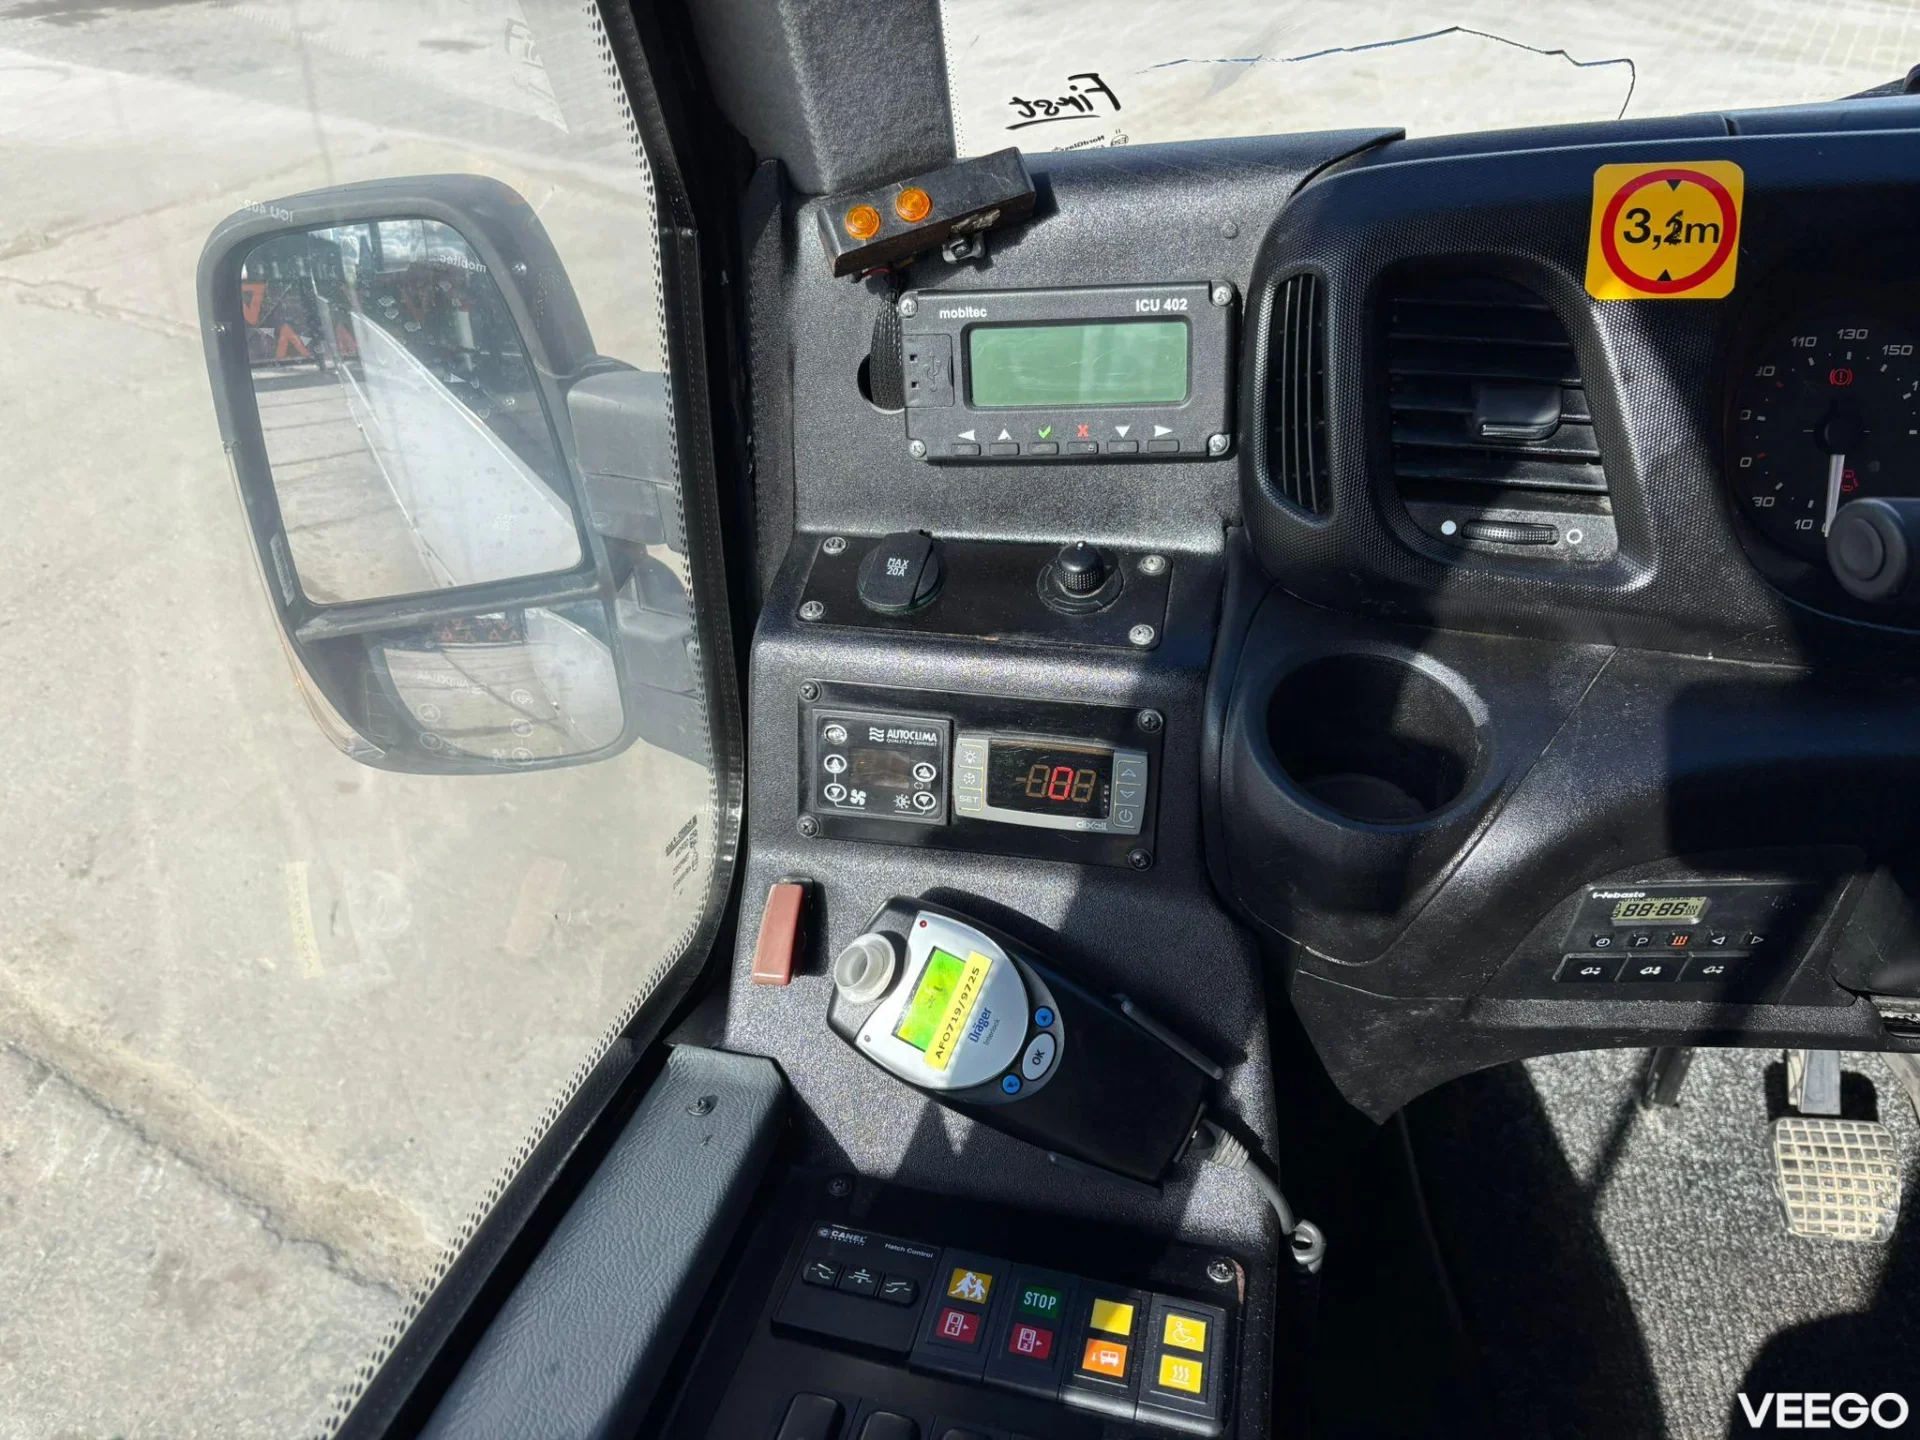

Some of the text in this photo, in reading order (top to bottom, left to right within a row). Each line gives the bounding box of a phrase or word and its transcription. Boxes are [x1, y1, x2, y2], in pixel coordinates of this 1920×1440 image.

[1136, 298, 1188, 312] ICU 402
[939, 307, 988, 320] mobitec
[1836, 328, 1869, 340] 130
[1790, 336, 1818, 348] 110
[1881, 344, 1913, 356] 150
[1794, 519, 1814, 531] 10
[887, 557, 908, 567] MAX
[886, 567, 905, 578] 20A
[886, 728, 938, 742] AUTOCLIMA
[959, 795, 978, 804] SET
[1592, 891, 1646, 900] Webasto
[1636, 936, 1649, 947] P
[969, 1007, 993, 1044] Dräger
[983, 1018, 1001, 1047] Interlock
[1031, 1048, 1046, 1066] OK
[831, 1229, 866, 1243] CANEL
[884, 1242, 934, 1258] Hatch Control
[1023, 1290, 1057, 1310] STOP
